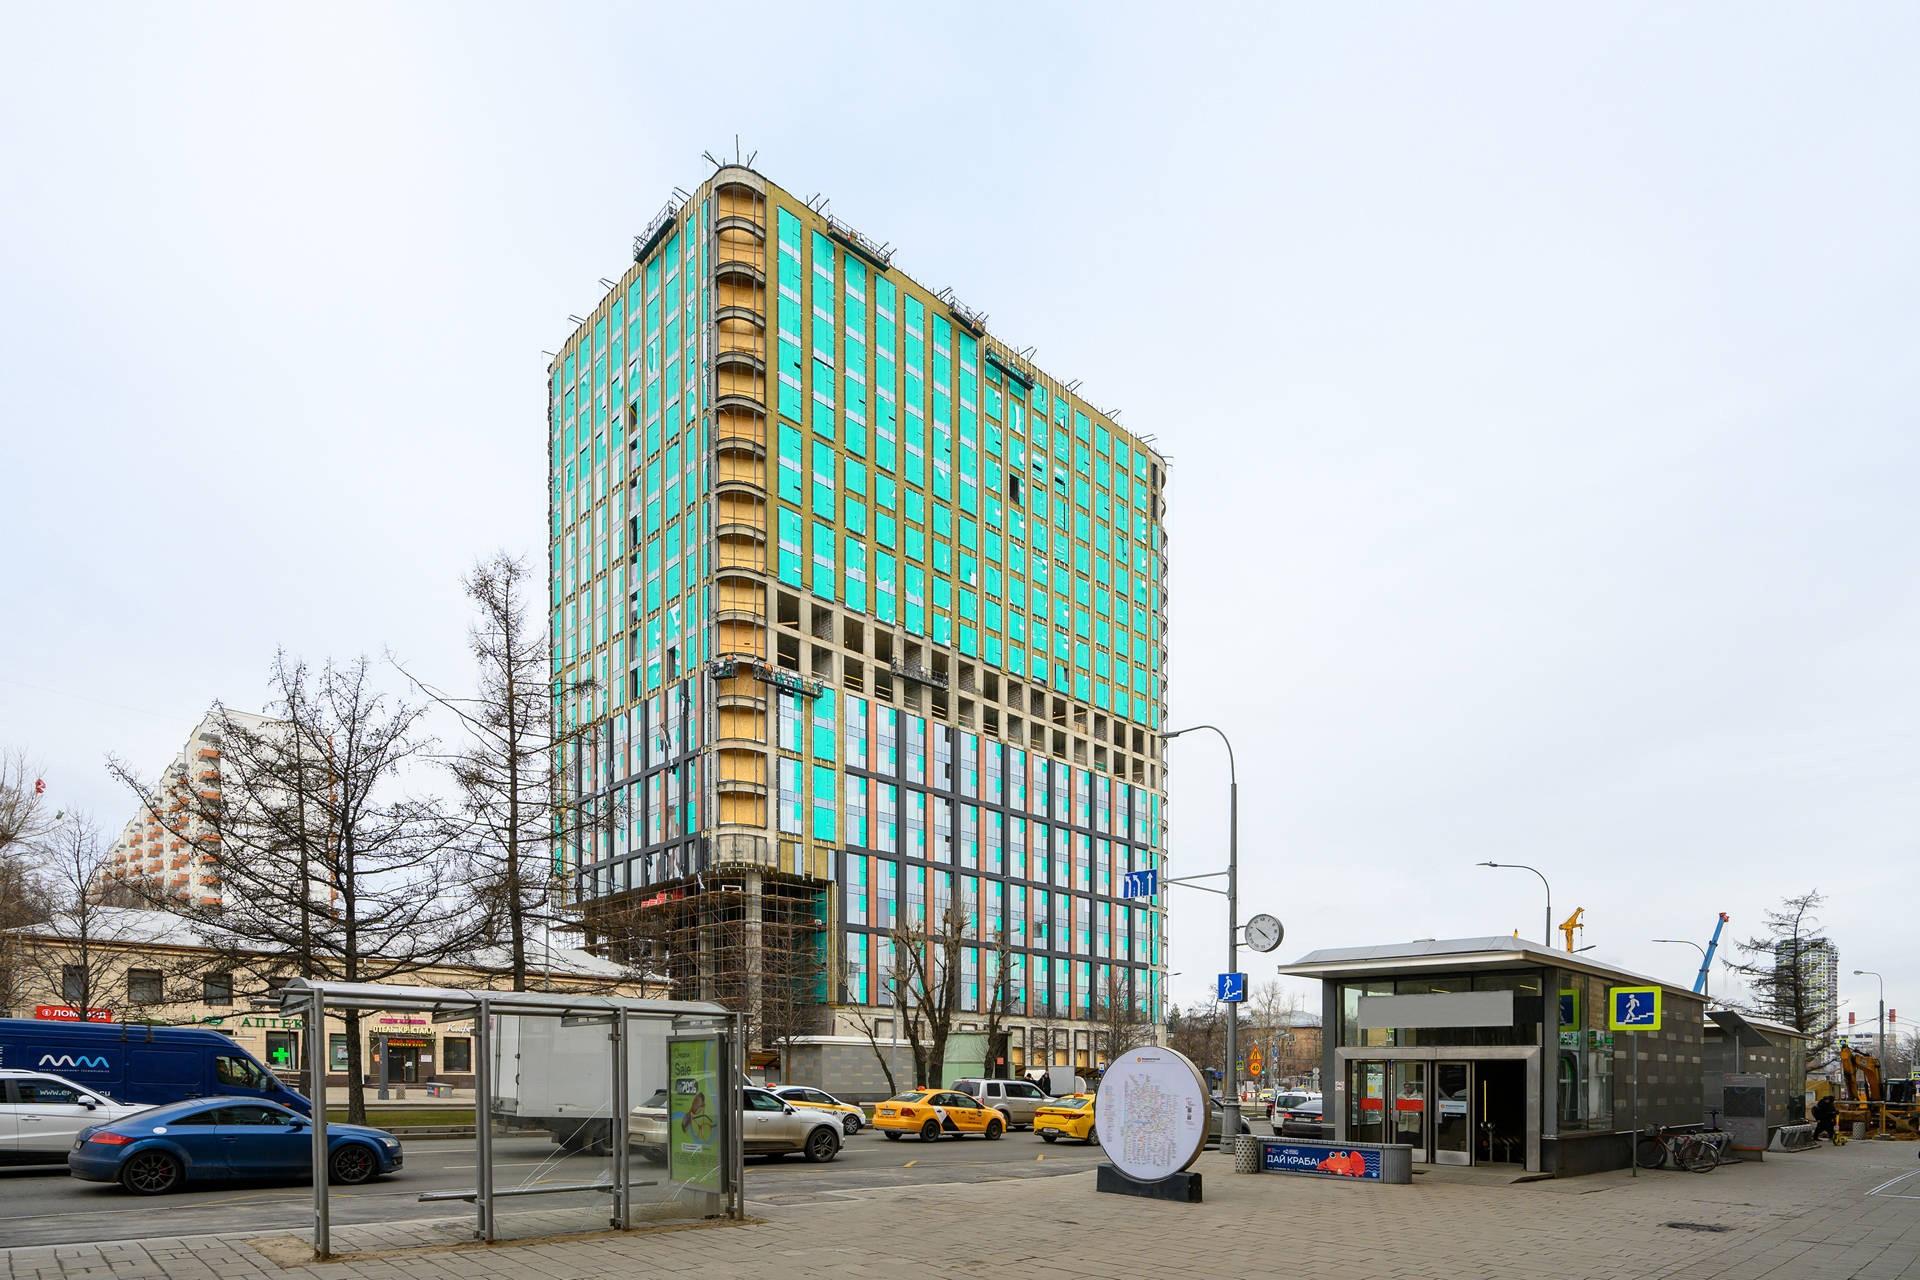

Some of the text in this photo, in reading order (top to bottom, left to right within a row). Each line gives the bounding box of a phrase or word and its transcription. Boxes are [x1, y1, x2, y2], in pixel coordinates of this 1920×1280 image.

[241, 1016, 303, 1029] АПТЕК
[674, 1062, 691, 1076] Sale
[1267, 1154, 1320, 1166] ДАЙ КРАБА!
